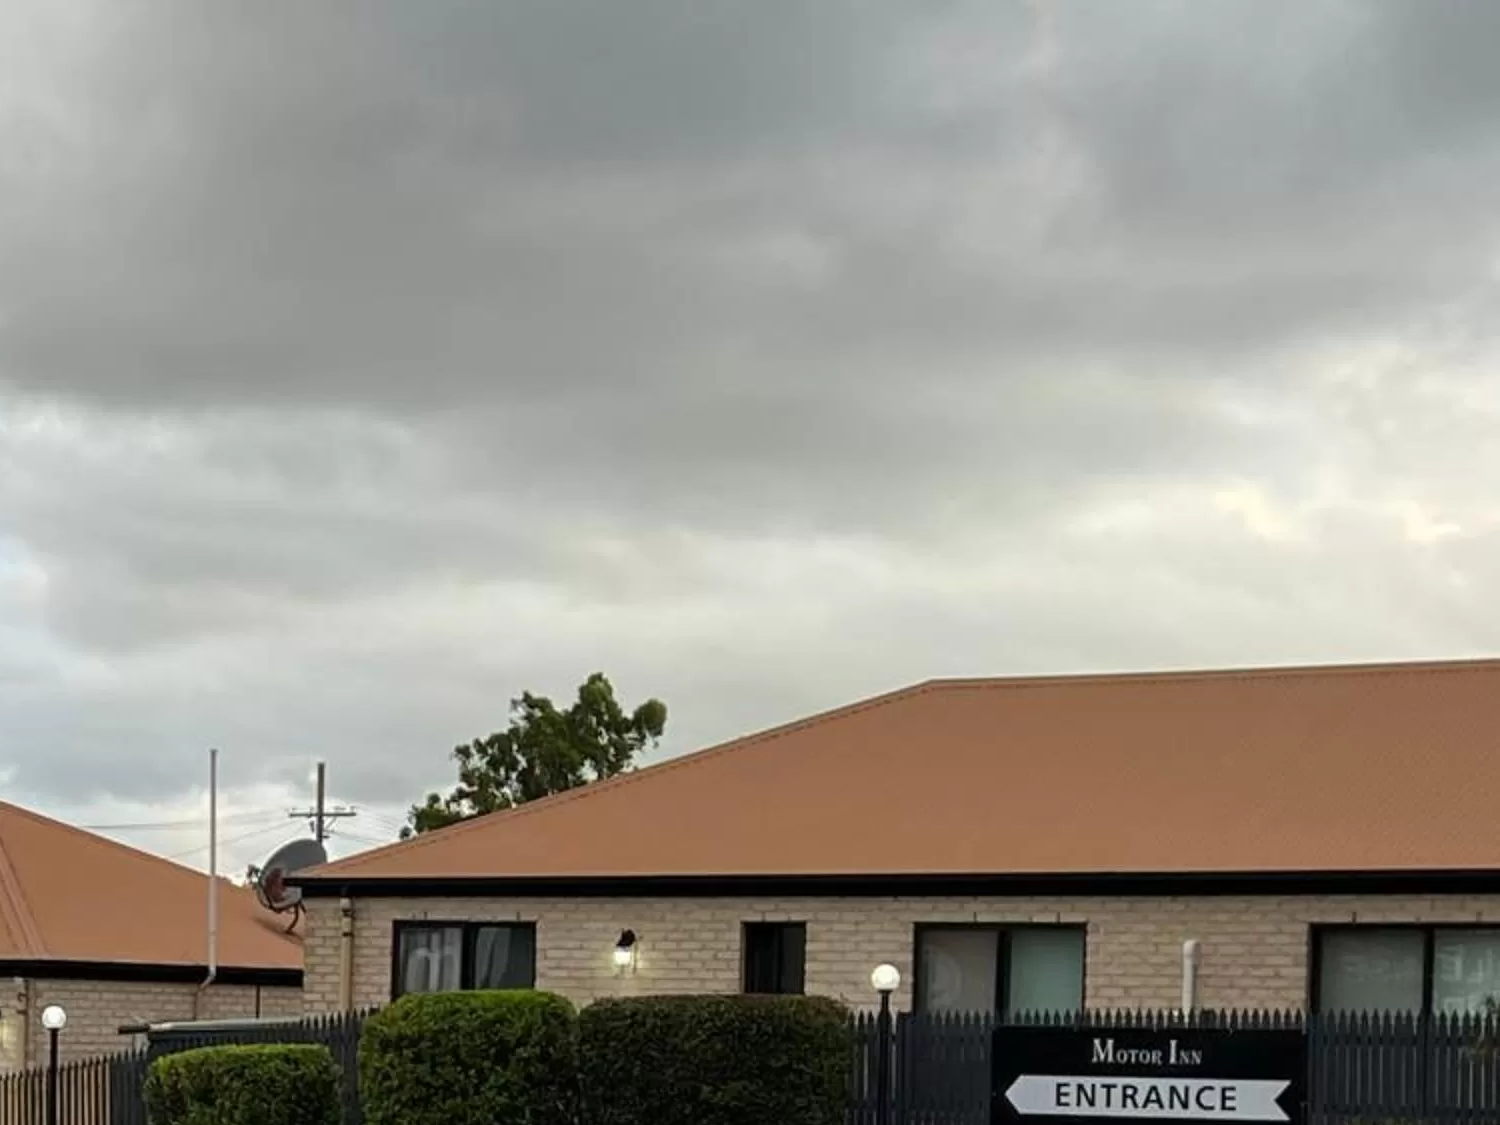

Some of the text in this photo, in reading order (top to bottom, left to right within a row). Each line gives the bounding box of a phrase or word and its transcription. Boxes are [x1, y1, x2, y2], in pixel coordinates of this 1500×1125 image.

[1091, 1037, 1203, 1066] MOTOR INN
[1055, 1082, 1237, 1112] ENTRANCE
